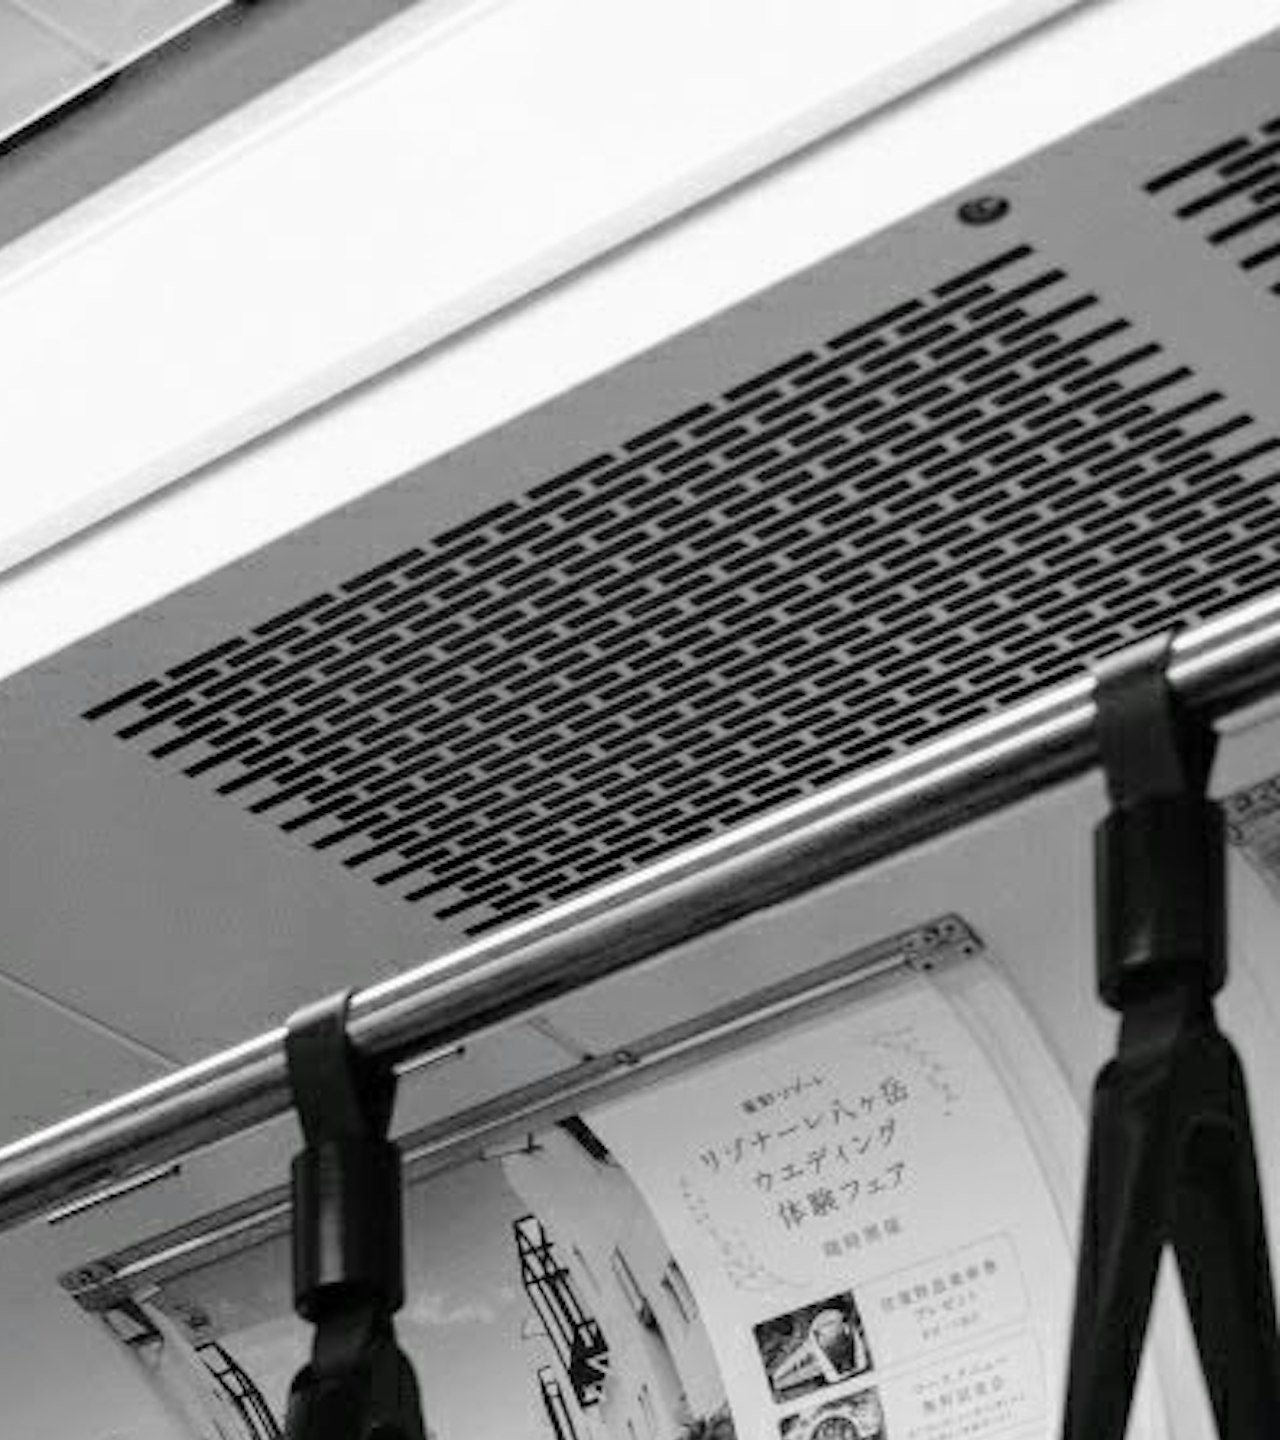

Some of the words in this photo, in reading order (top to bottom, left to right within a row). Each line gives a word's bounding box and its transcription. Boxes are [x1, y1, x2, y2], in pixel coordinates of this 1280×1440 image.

[777, 1160, 906, 1230] 体験フェア
